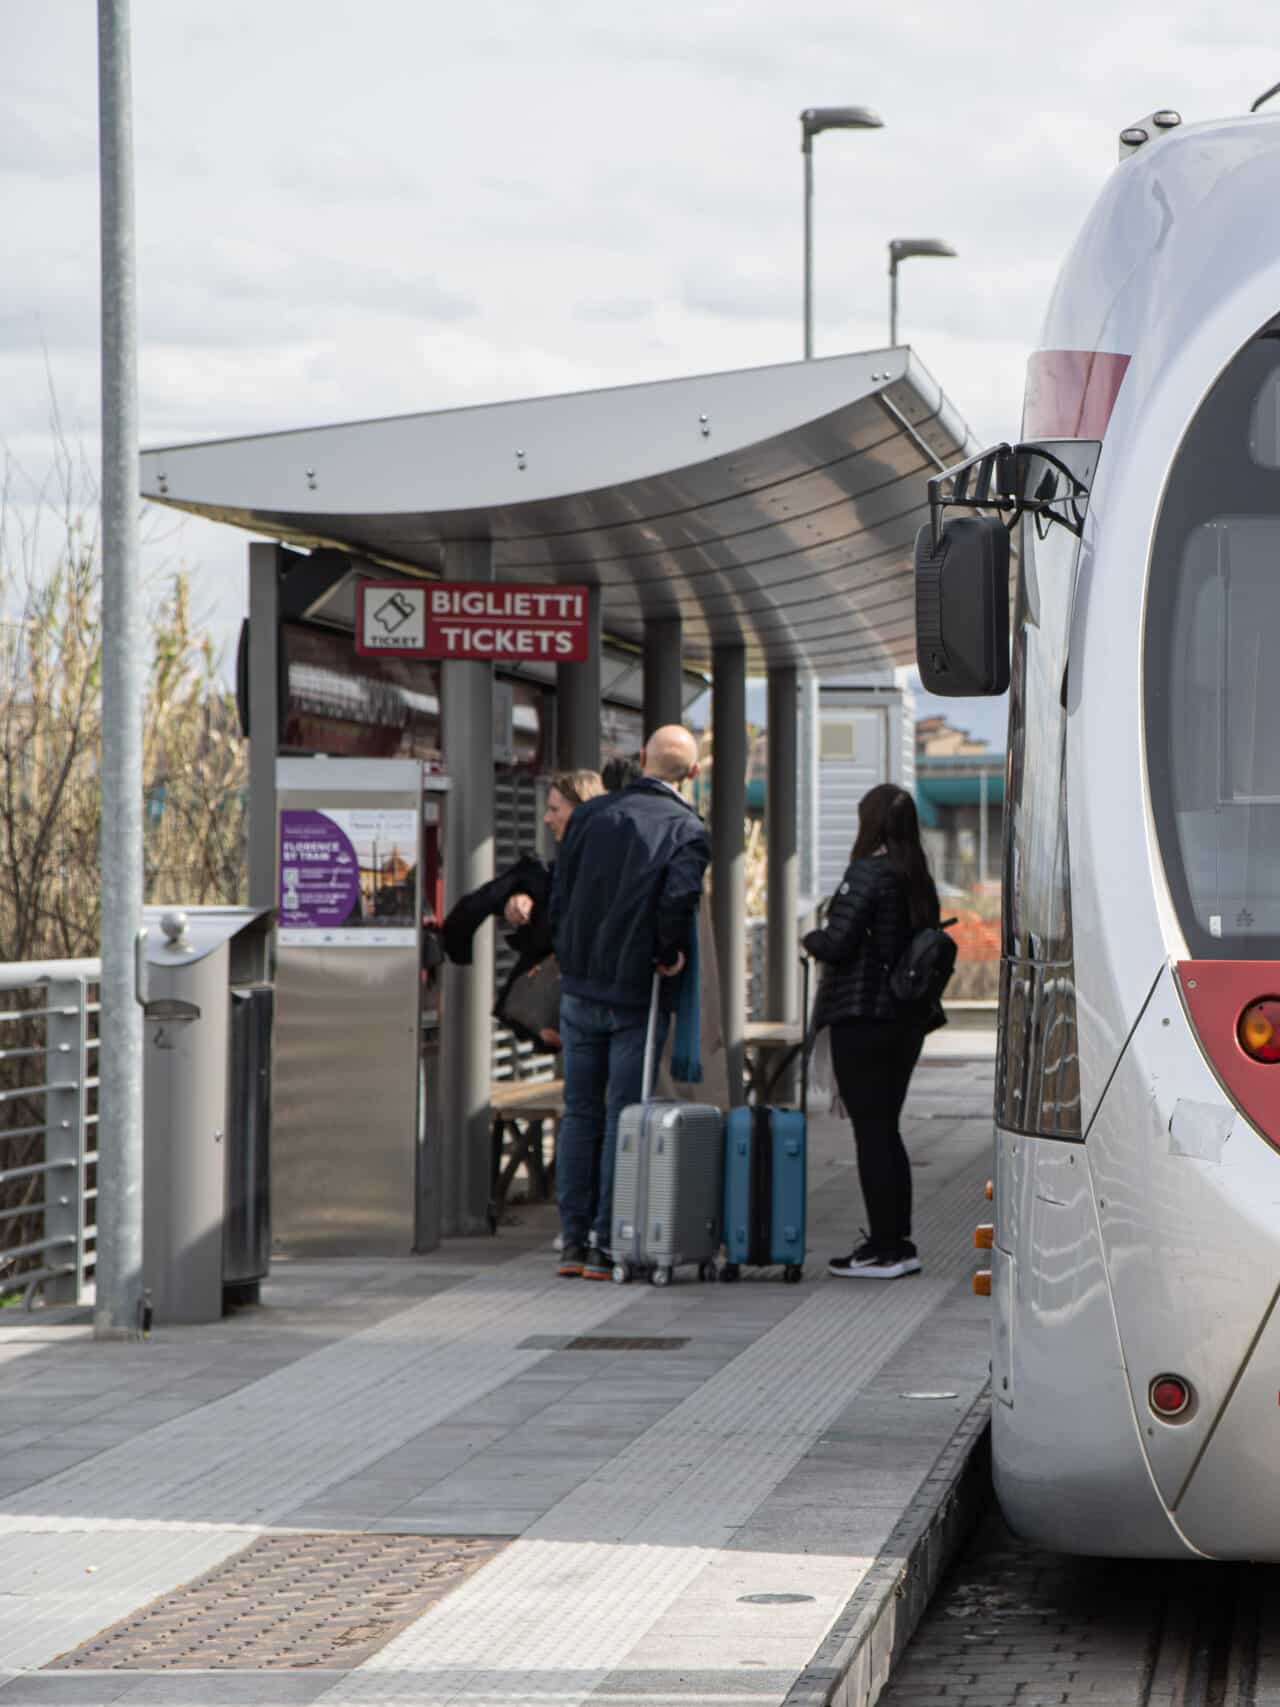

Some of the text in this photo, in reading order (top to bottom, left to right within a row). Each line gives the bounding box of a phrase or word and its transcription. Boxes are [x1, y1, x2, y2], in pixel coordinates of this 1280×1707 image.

[431, 590, 583, 618] BIGLIETTI
[370, 635, 418, 647] TICKET
[440, 627, 573, 654] TICKETS
